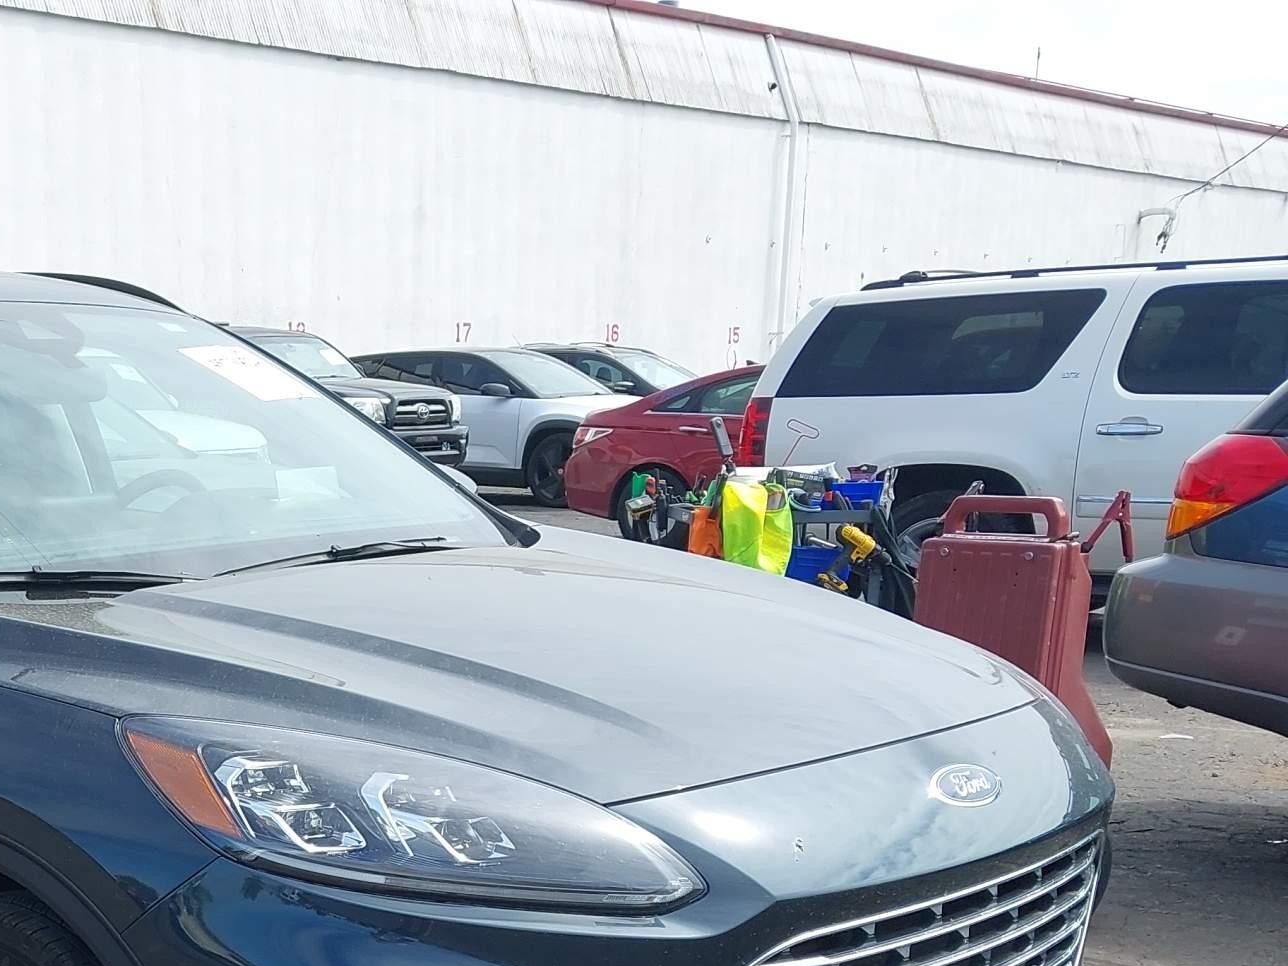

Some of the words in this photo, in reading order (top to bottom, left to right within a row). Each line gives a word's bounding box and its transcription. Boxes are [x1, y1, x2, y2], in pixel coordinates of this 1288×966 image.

[455, 322, 472, 343] 17
[605, 323, 620, 342] 16
[728, 326, 740, 344] 15
[950, 770, 992, 797] Ford
